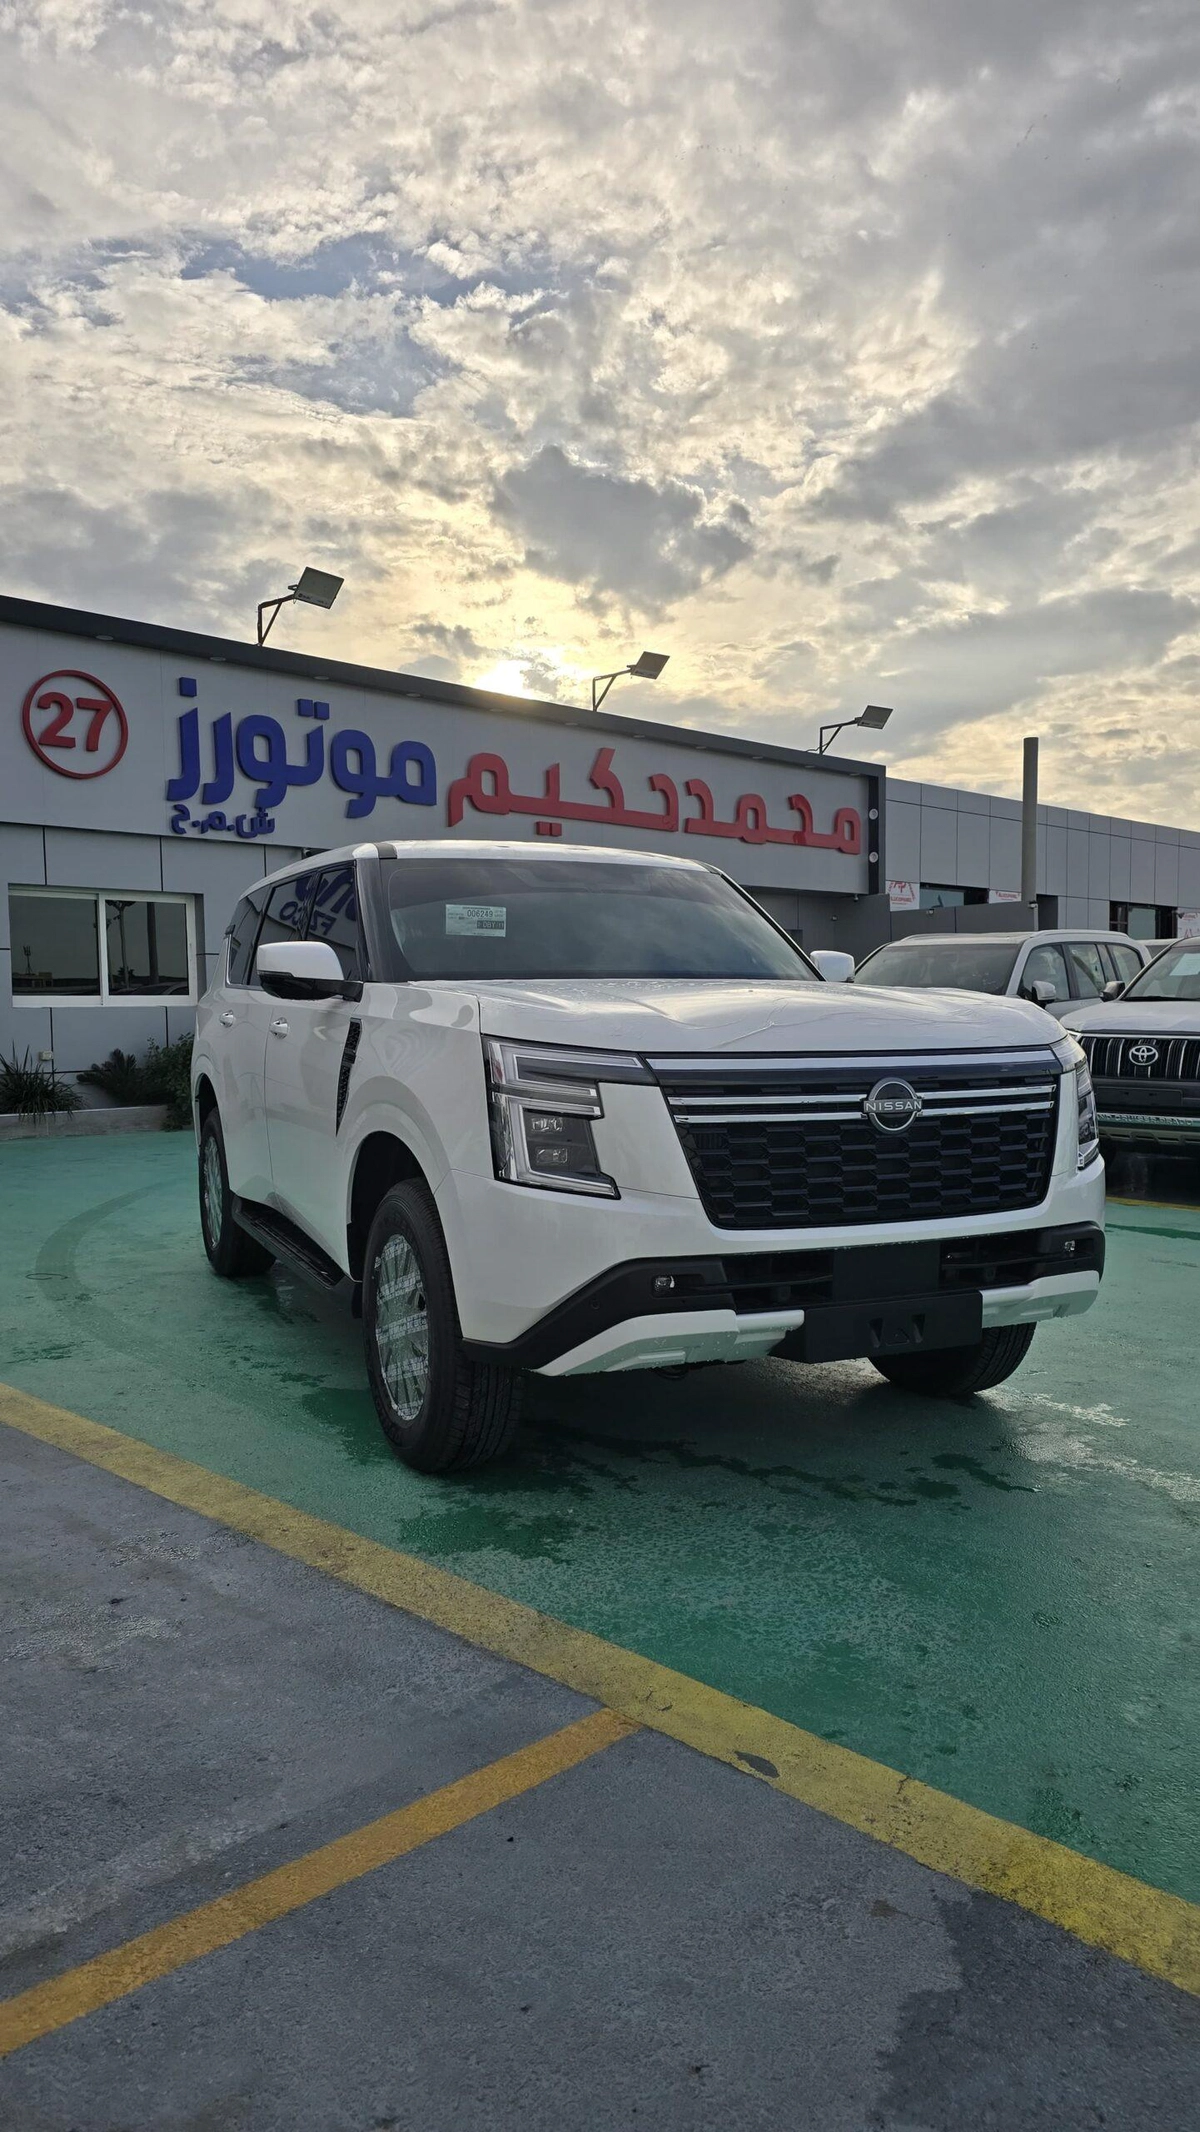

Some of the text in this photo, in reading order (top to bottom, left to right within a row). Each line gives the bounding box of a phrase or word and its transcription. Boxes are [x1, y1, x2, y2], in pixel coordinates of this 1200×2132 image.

[37, 692, 113, 752] 27
[166, 676, 861, 855] محمد حكيم موتورز
[466, 909, 494, 918] 006249
[865, 1100, 922, 1111] NISSAN
